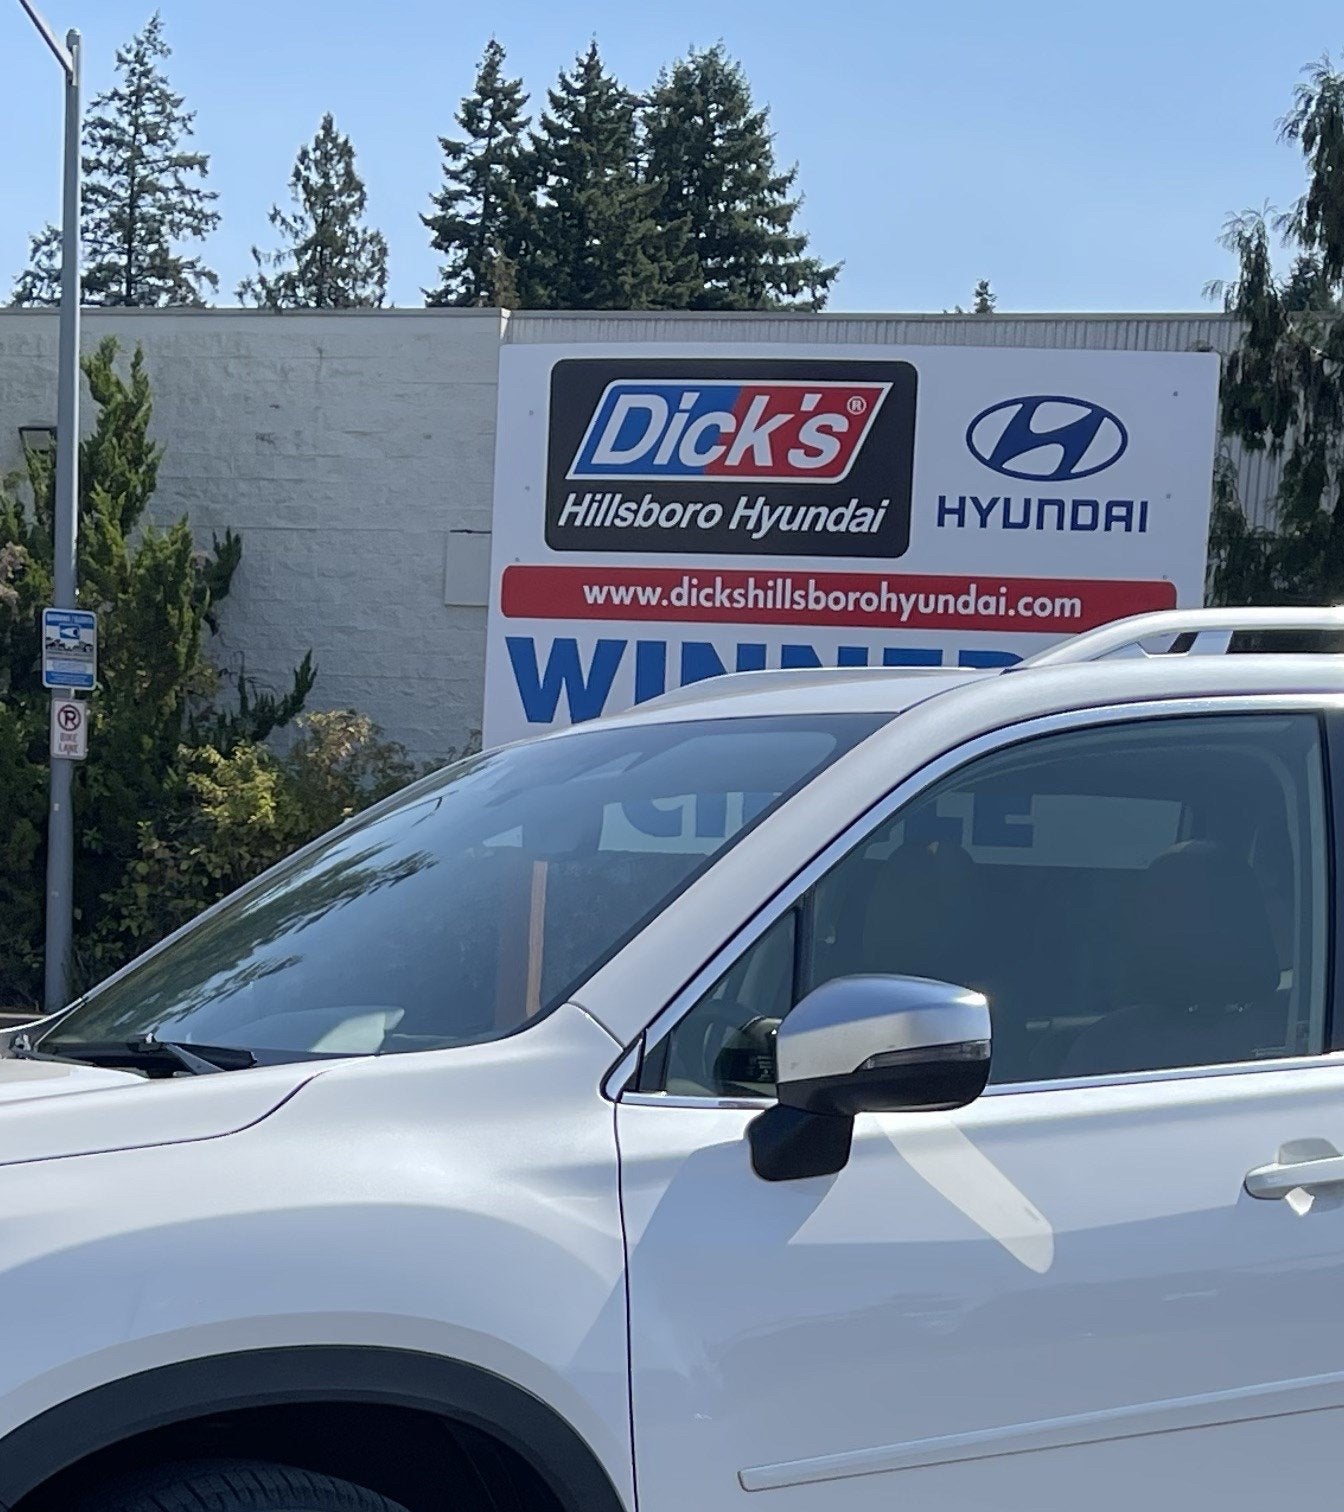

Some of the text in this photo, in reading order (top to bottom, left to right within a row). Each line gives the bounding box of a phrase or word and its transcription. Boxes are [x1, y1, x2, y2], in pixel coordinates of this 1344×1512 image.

[590, 391, 851, 470] Dick's
[557, 493, 890, 540] Hillsboro Hyundai
[936, 495, 1149, 533] HYUNDAI
[582, 577, 1082, 621] www.dickshillsborohyundai.com
